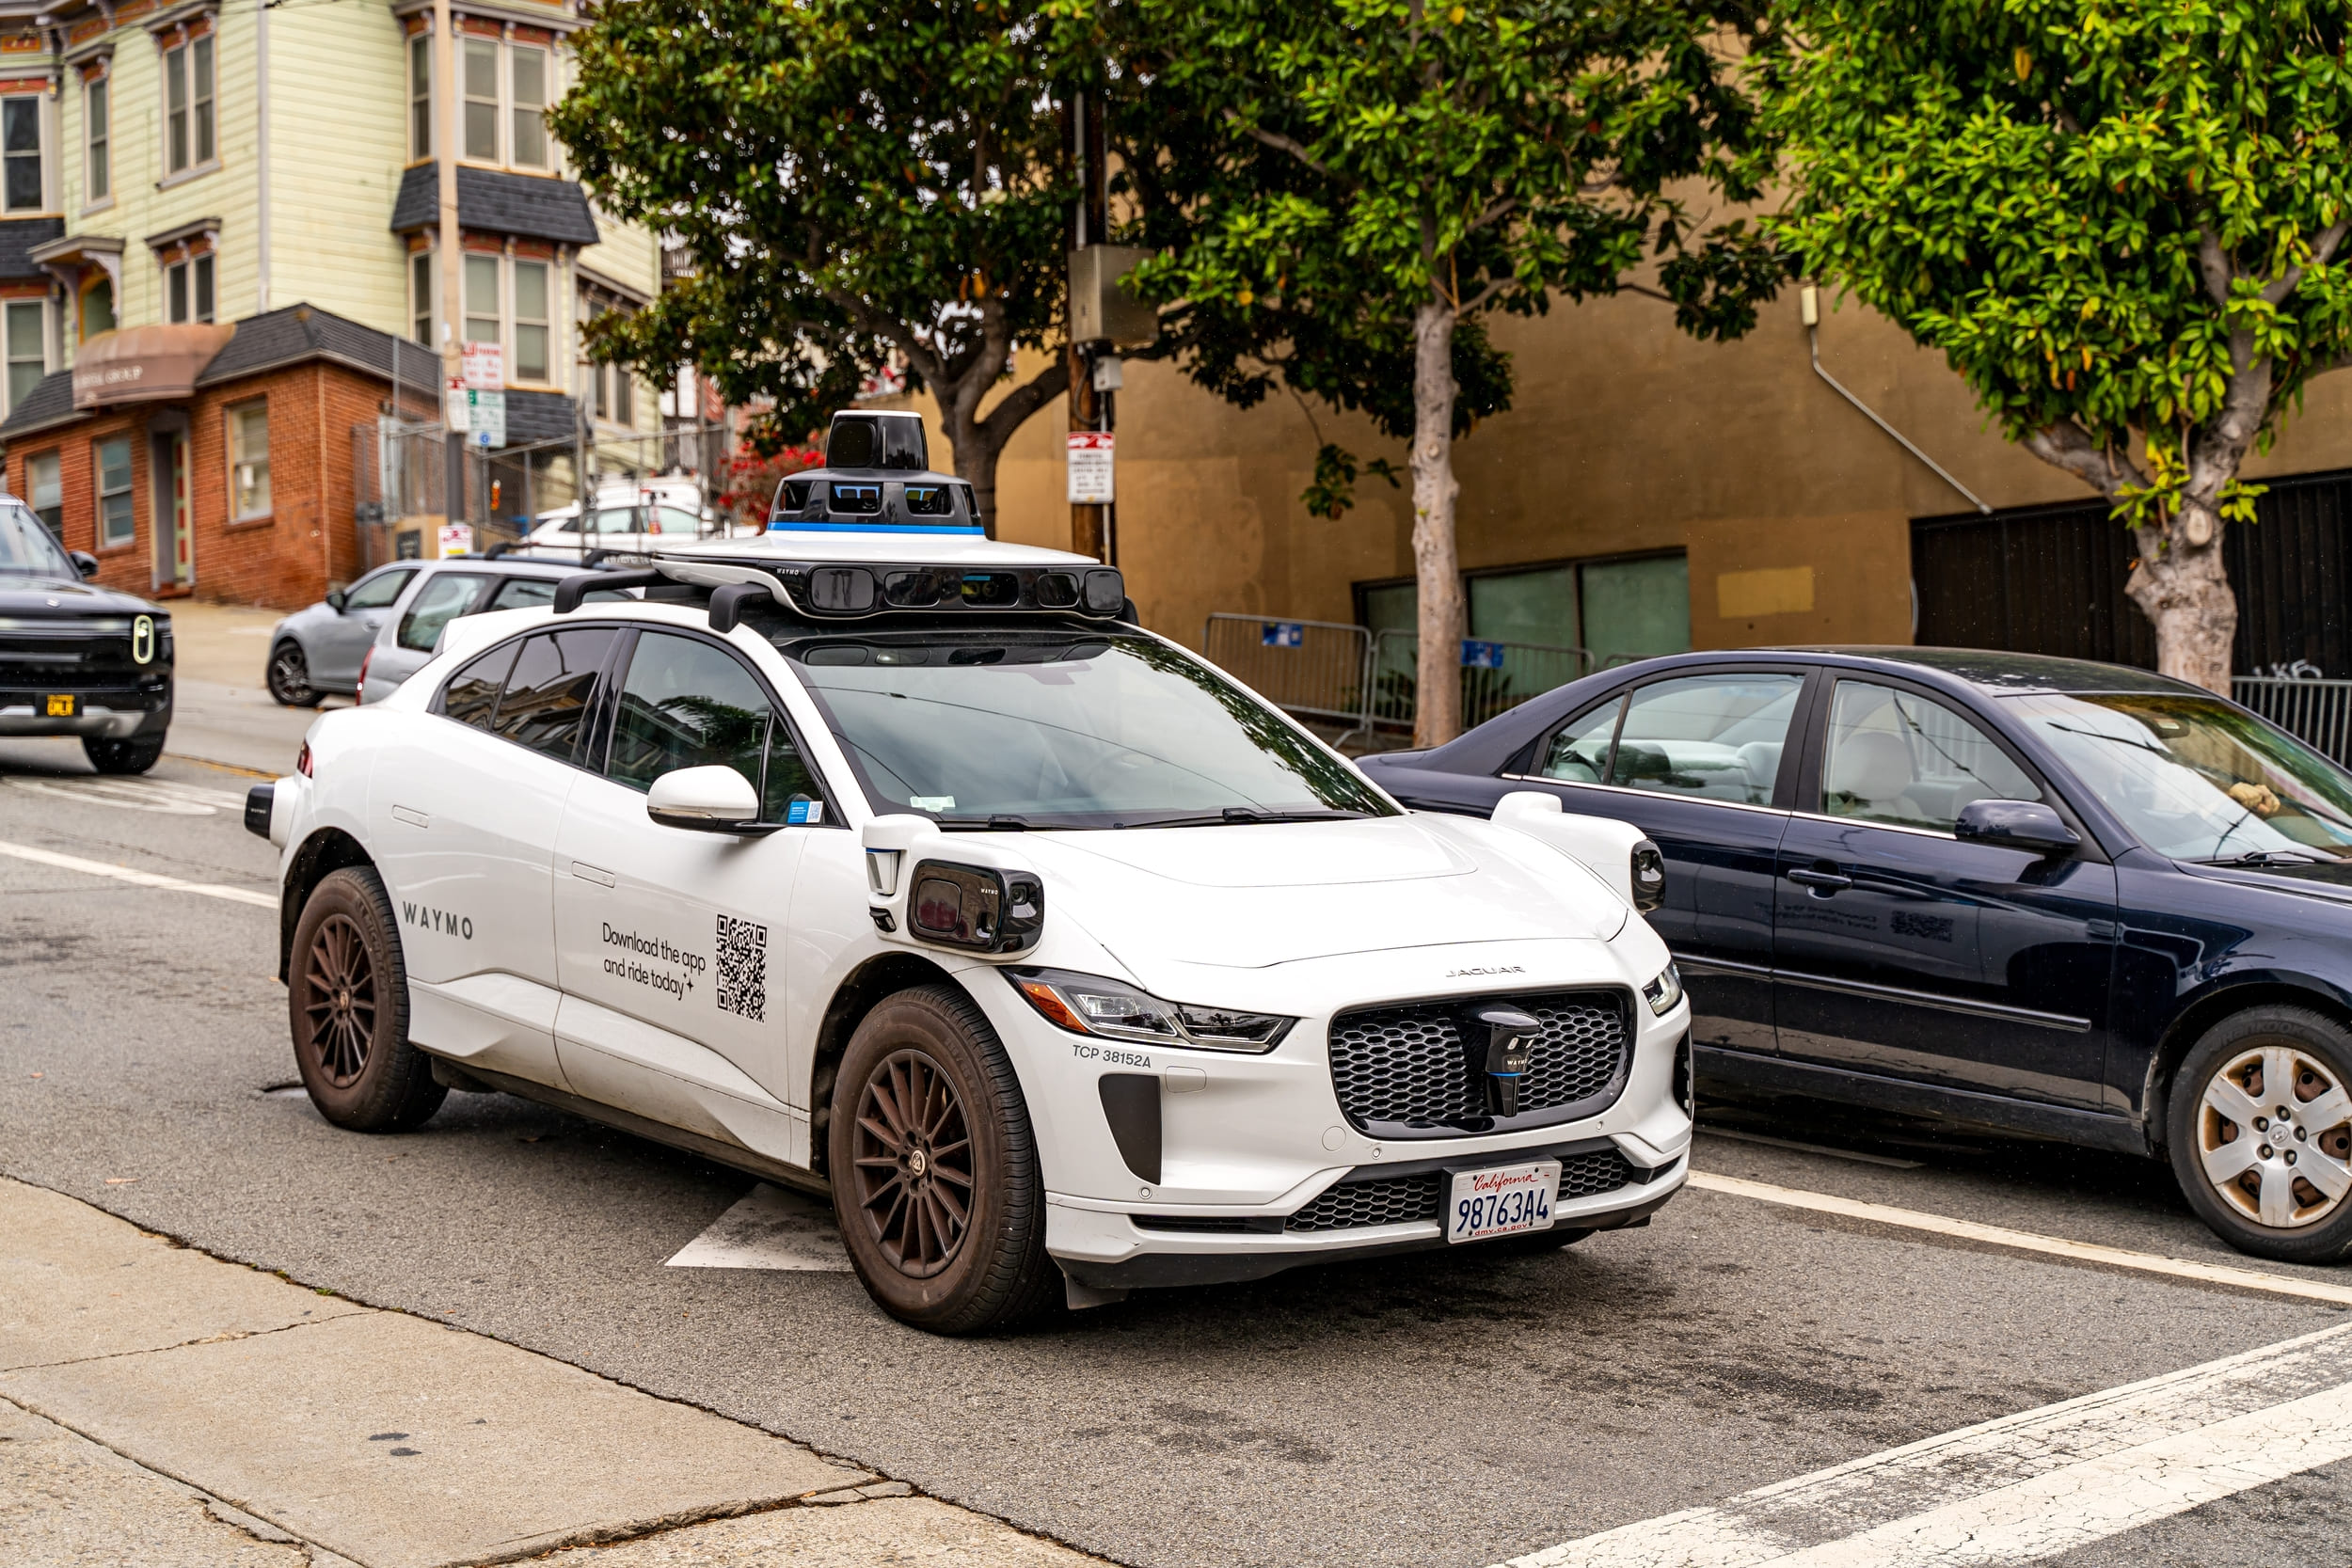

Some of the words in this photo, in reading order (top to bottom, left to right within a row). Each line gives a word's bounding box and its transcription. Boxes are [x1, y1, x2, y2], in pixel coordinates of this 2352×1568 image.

[776, 567, 800, 576] WAYMO
[980, 887, 998, 895] WAYMO
[403, 900, 473, 941] WAYMO
[602, 922, 659, 958] Download
[661, 940, 679, 963] the
[682, 951, 707, 975] app
[604, 958, 626, 977] and
[628, 961, 649, 985] ride
[651, 969, 685, 1001] today
[1445, 966, 1526, 977] JAGUAR
[1073, 1044, 1100, 1059] TCP
[1103, 1050, 1152, 1069] 38152A
[1474, 1172, 1539, 1193] California
[1456, 1188, 1549, 1232] 98763A4
[1474, 1223, 1528, 1236] dmv.ca.gov
